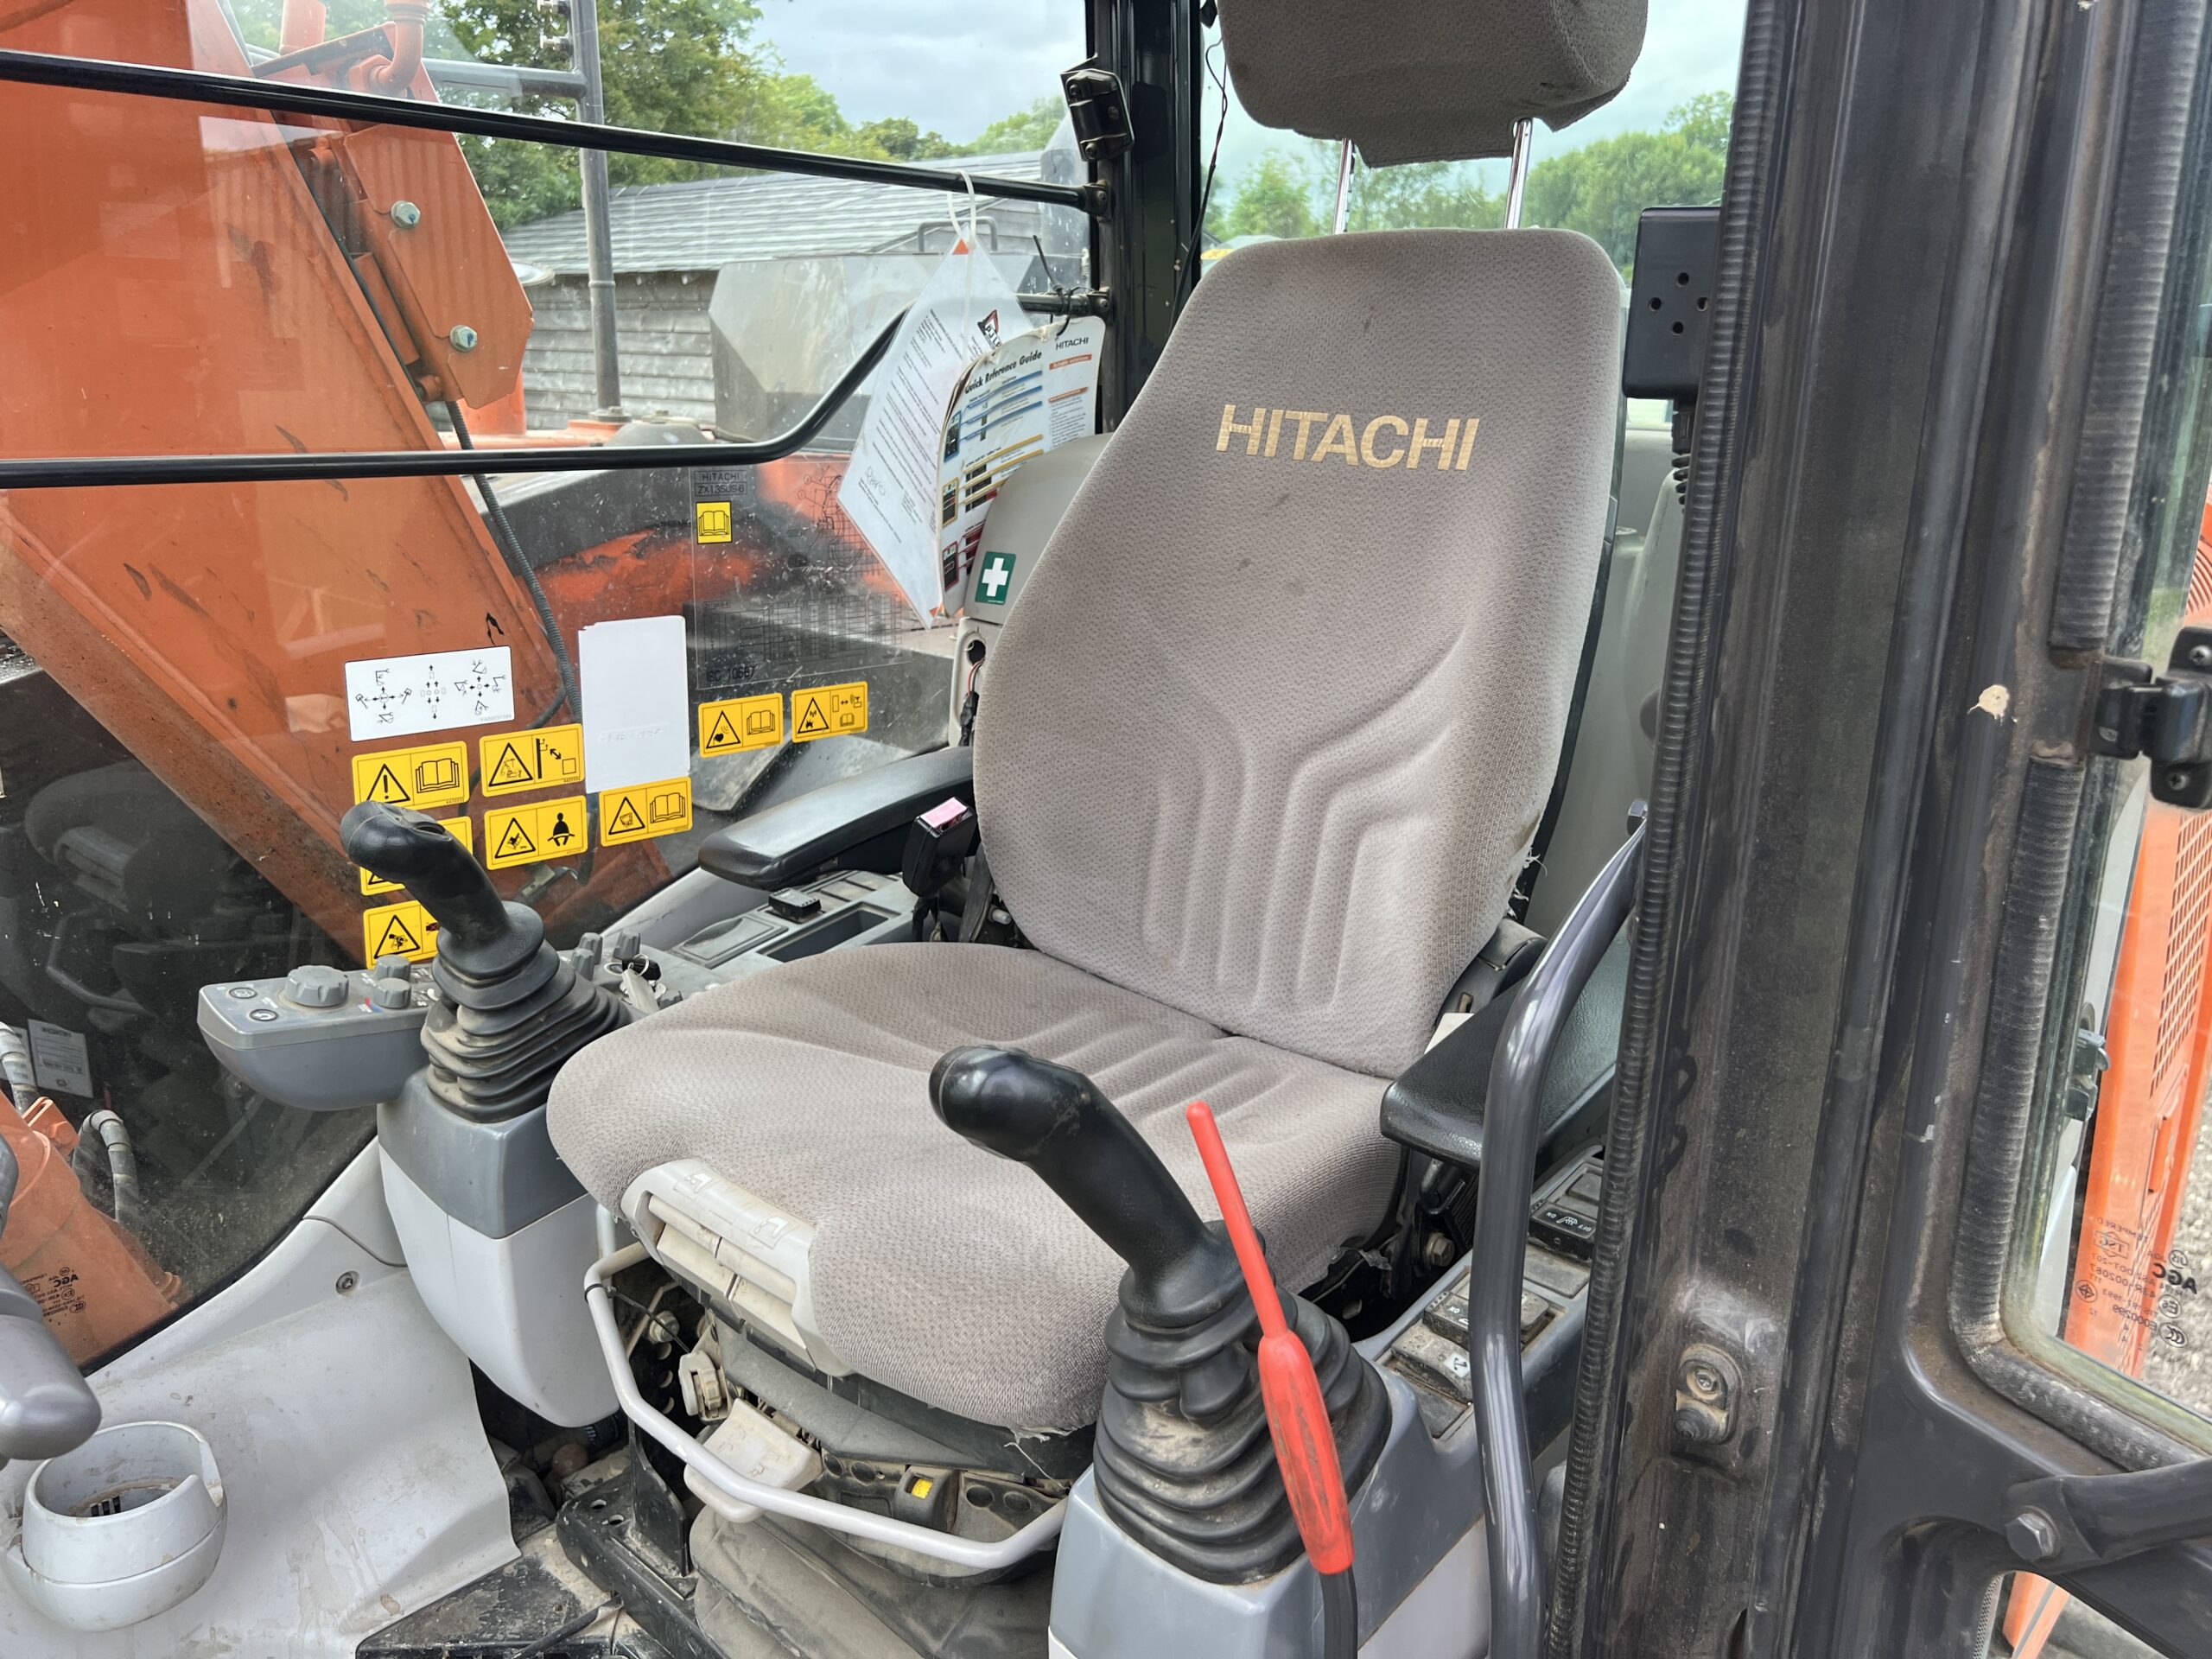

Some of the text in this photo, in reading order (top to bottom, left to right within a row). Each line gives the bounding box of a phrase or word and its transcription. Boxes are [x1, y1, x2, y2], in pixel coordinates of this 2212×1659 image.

[1055, 337, 1089, 350] HITACHI
[985, 361, 1017, 384] Reference
[1019, 350, 1042, 365] Guide
[1216, 404, 1479, 470] HITACHI
[702, 473, 740, 481] HITACHI
[1577, 1224, 1592, 1233] OFF
[1448, 1306, 1460, 1314] ON
